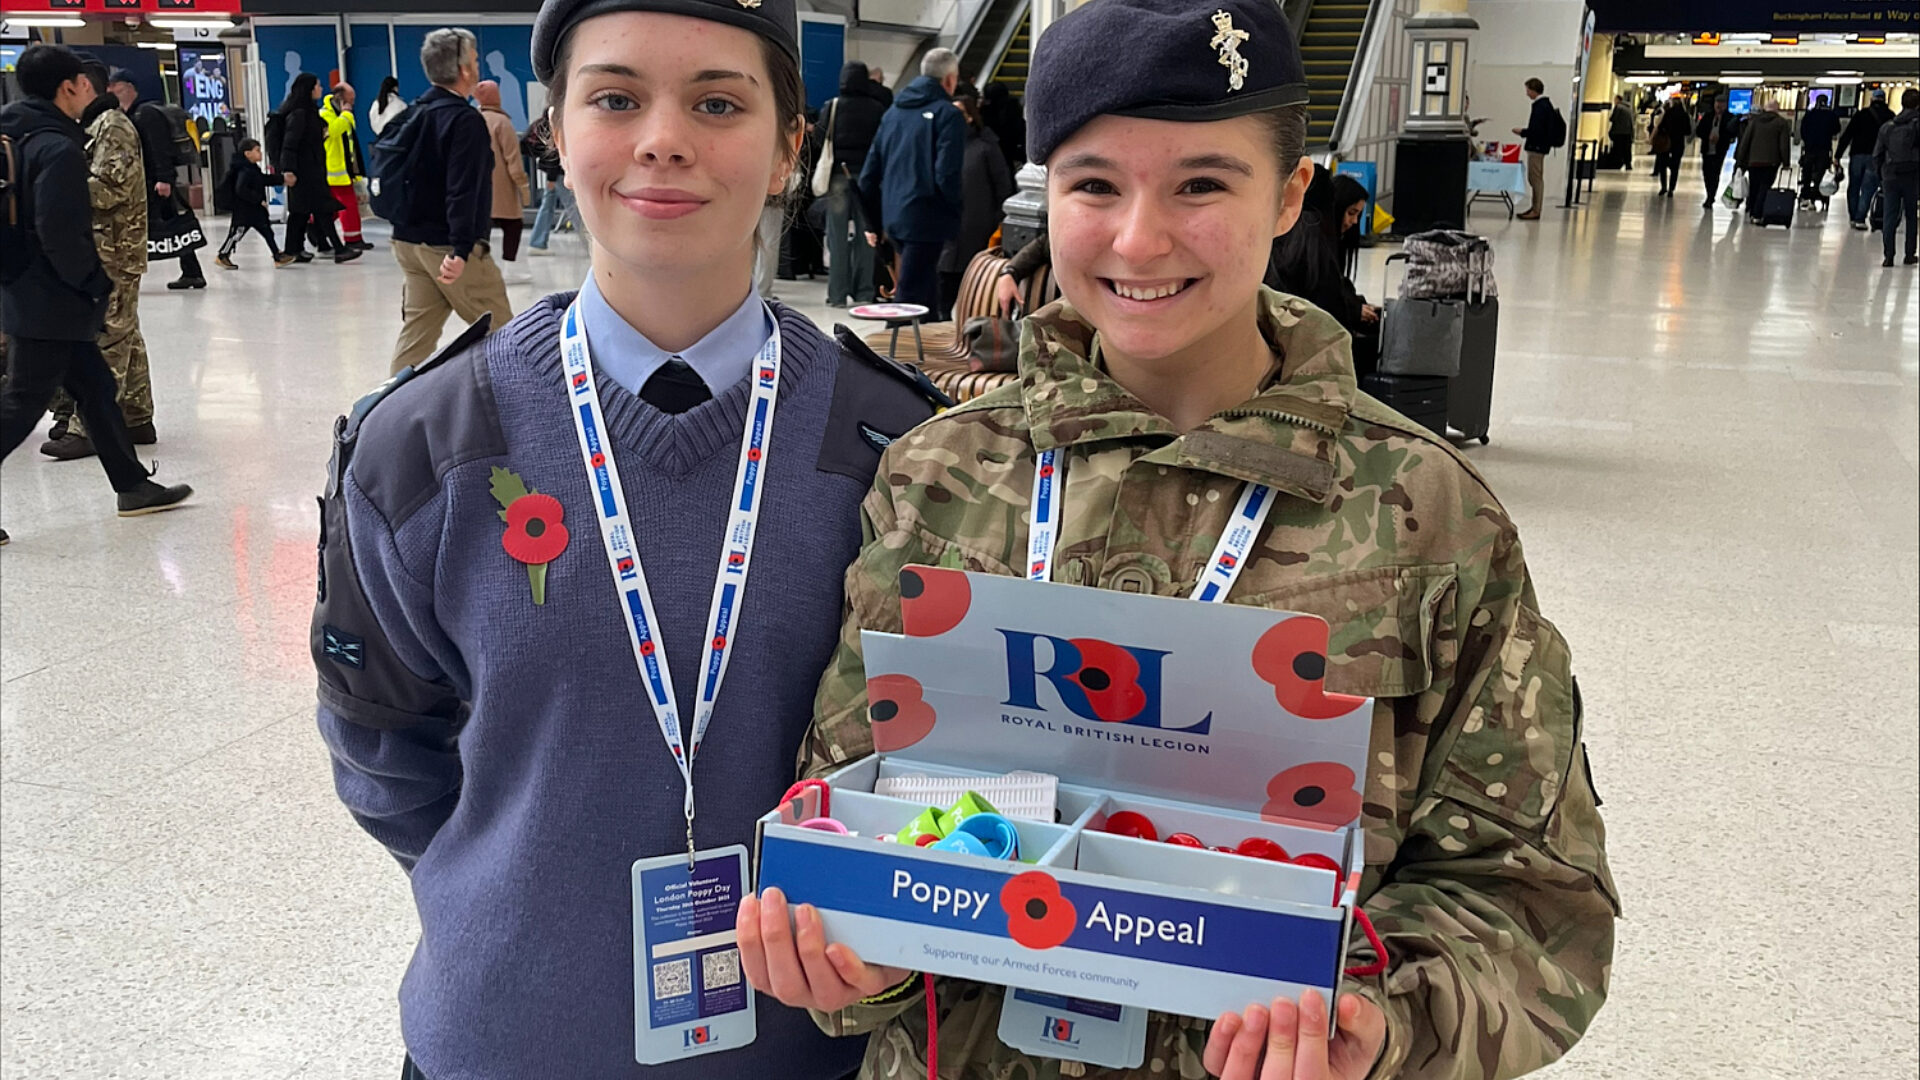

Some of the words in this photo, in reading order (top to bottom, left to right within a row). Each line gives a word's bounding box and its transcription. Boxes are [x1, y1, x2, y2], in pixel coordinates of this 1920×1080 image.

[1887, 9, 1911, 21] Way
[196, 74, 224, 99] ENG
[147, 229, 202, 253] adidas
[585, 426, 599, 452] Appeal
[746, 461, 757, 485] Poppy
[754, 420, 763, 447] Appeal
[599, 467, 609, 491] Poppy
[1040, 478, 1050, 500] Poppy
[634, 613, 649, 640] Appeal
[709, 651, 721, 675] Poppy
[718, 607, 729, 635] Appeal
[647, 656, 658, 680] Poppy
[1001, 714, 1057, 731] ROYAL
[1063, 725, 1135, 745] BRITISH
[1141, 737, 1211, 755] LEGION
[654, 892, 687, 905] London
[687, 887, 713, 899] Poppy
[714, 884, 732, 894] Day
[664, 881, 688, 892] Official
[688, 877, 720, 888] Volunteer
[892, 869, 990, 920] Poppy
[1085, 900, 1206, 946] Appeal
[923, 943, 980, 966] Supporting
[981, 954, 1001, 966] our
[1002, 957, 1040, 973] Armed
[1042, 962, 1078, 979] Forces
[1079, 970, 1140, 990] community
